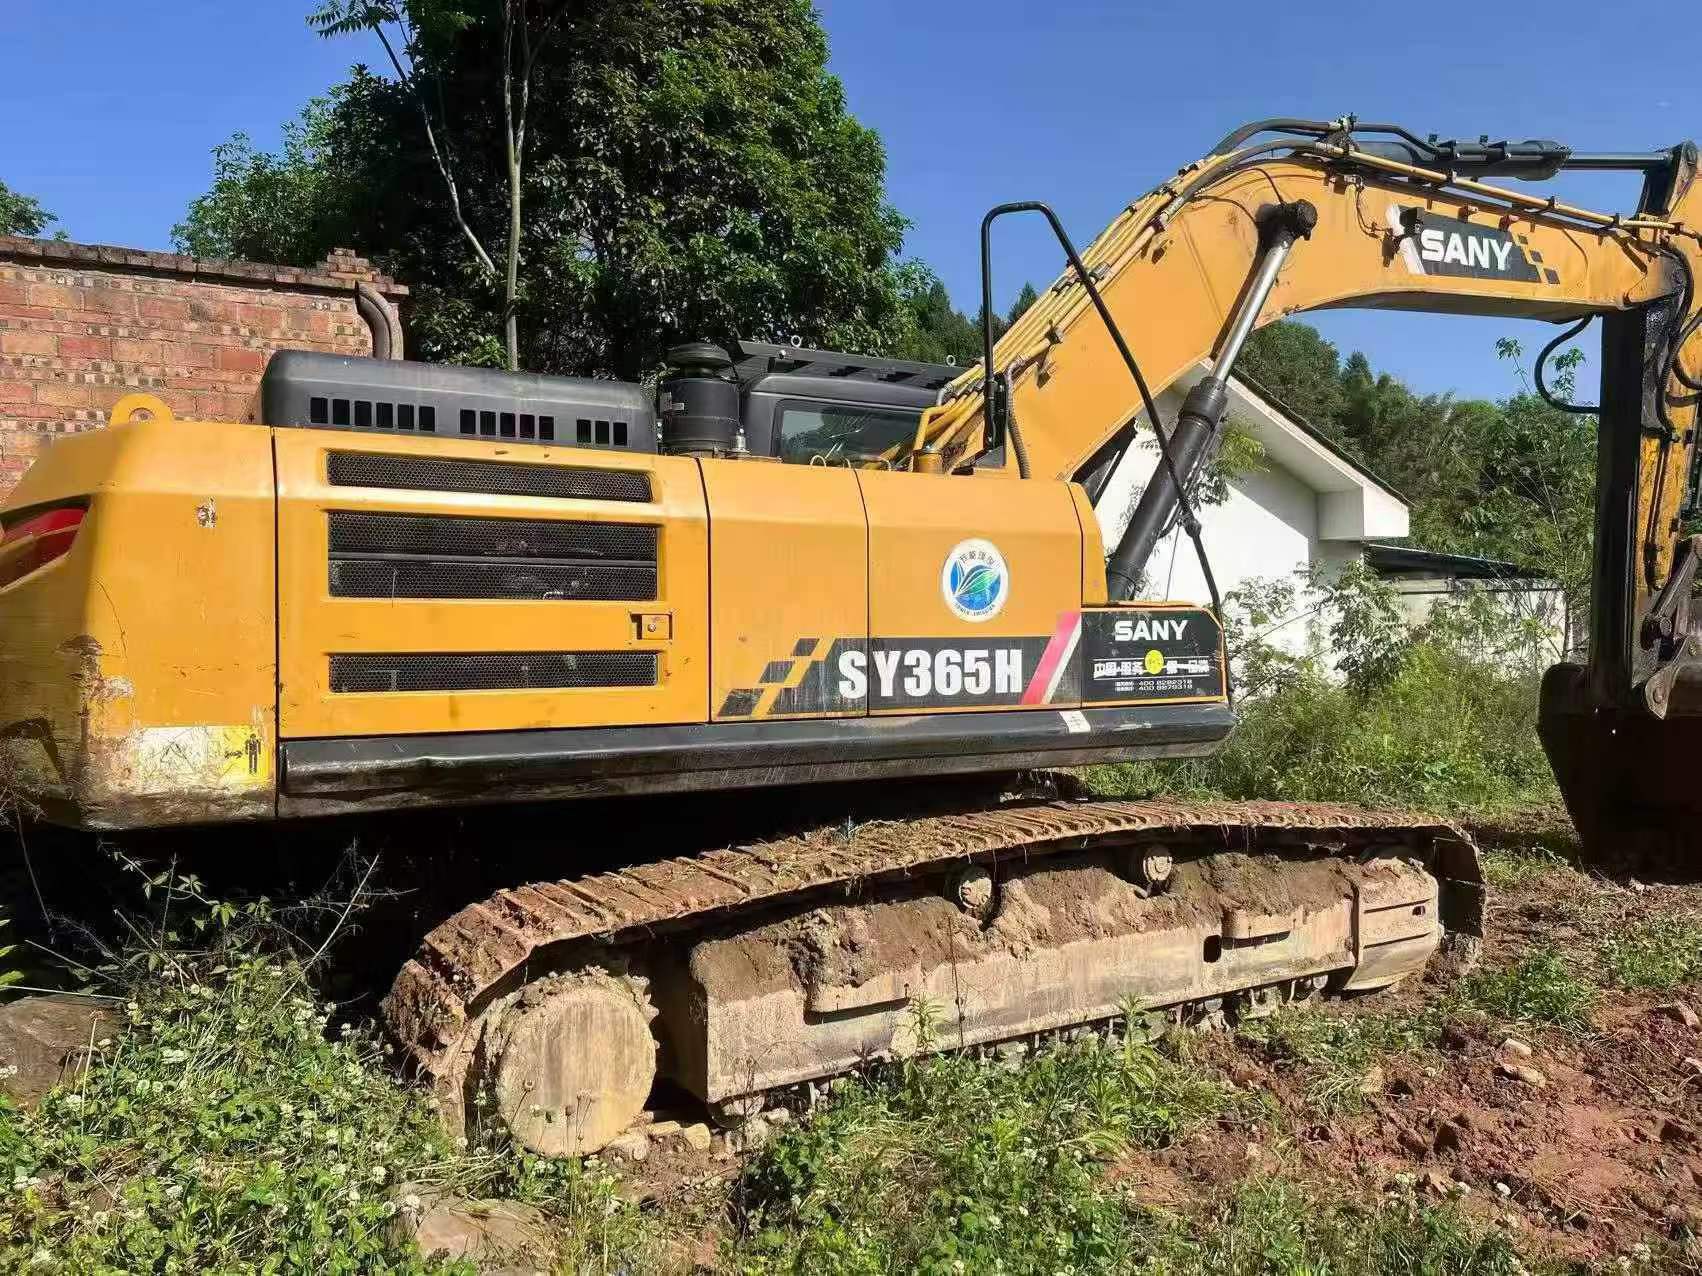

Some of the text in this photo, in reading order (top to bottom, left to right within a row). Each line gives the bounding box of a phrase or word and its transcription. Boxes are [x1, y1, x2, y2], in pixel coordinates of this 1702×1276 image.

[1420, 228, 1513, 271] SANY
[1115, 619, 1188, 641] SANY
[838, 649, 1023, 699] SY365H
